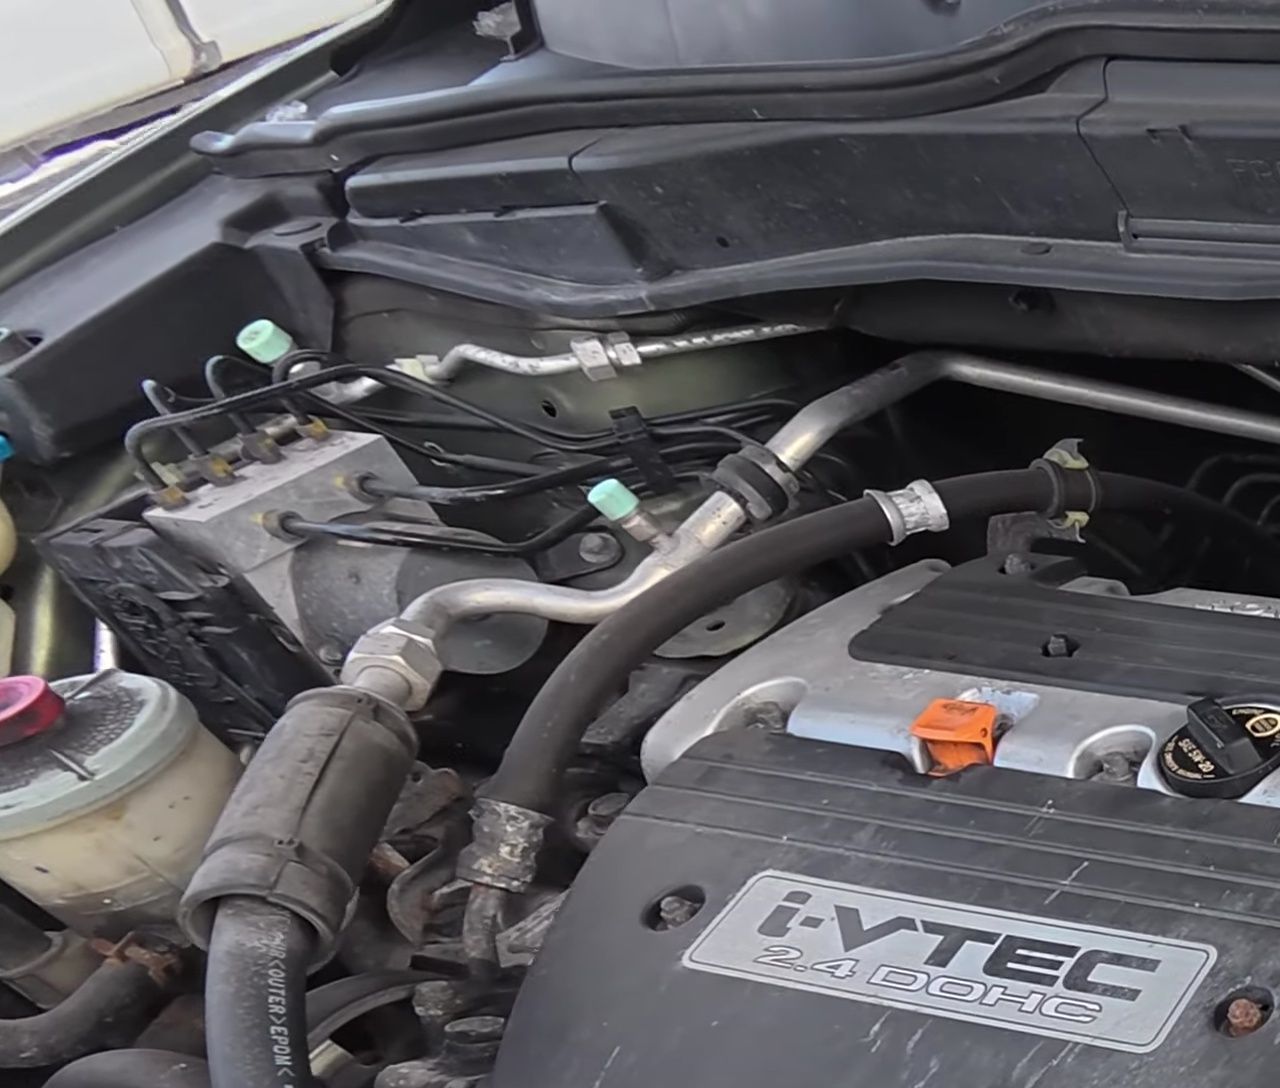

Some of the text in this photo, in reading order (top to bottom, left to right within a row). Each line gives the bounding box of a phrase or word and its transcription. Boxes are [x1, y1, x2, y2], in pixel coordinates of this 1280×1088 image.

[754, 945, 1103, 1024] 2.4 DOHC
[757, 890, 1163, 1002] i-VTEC
